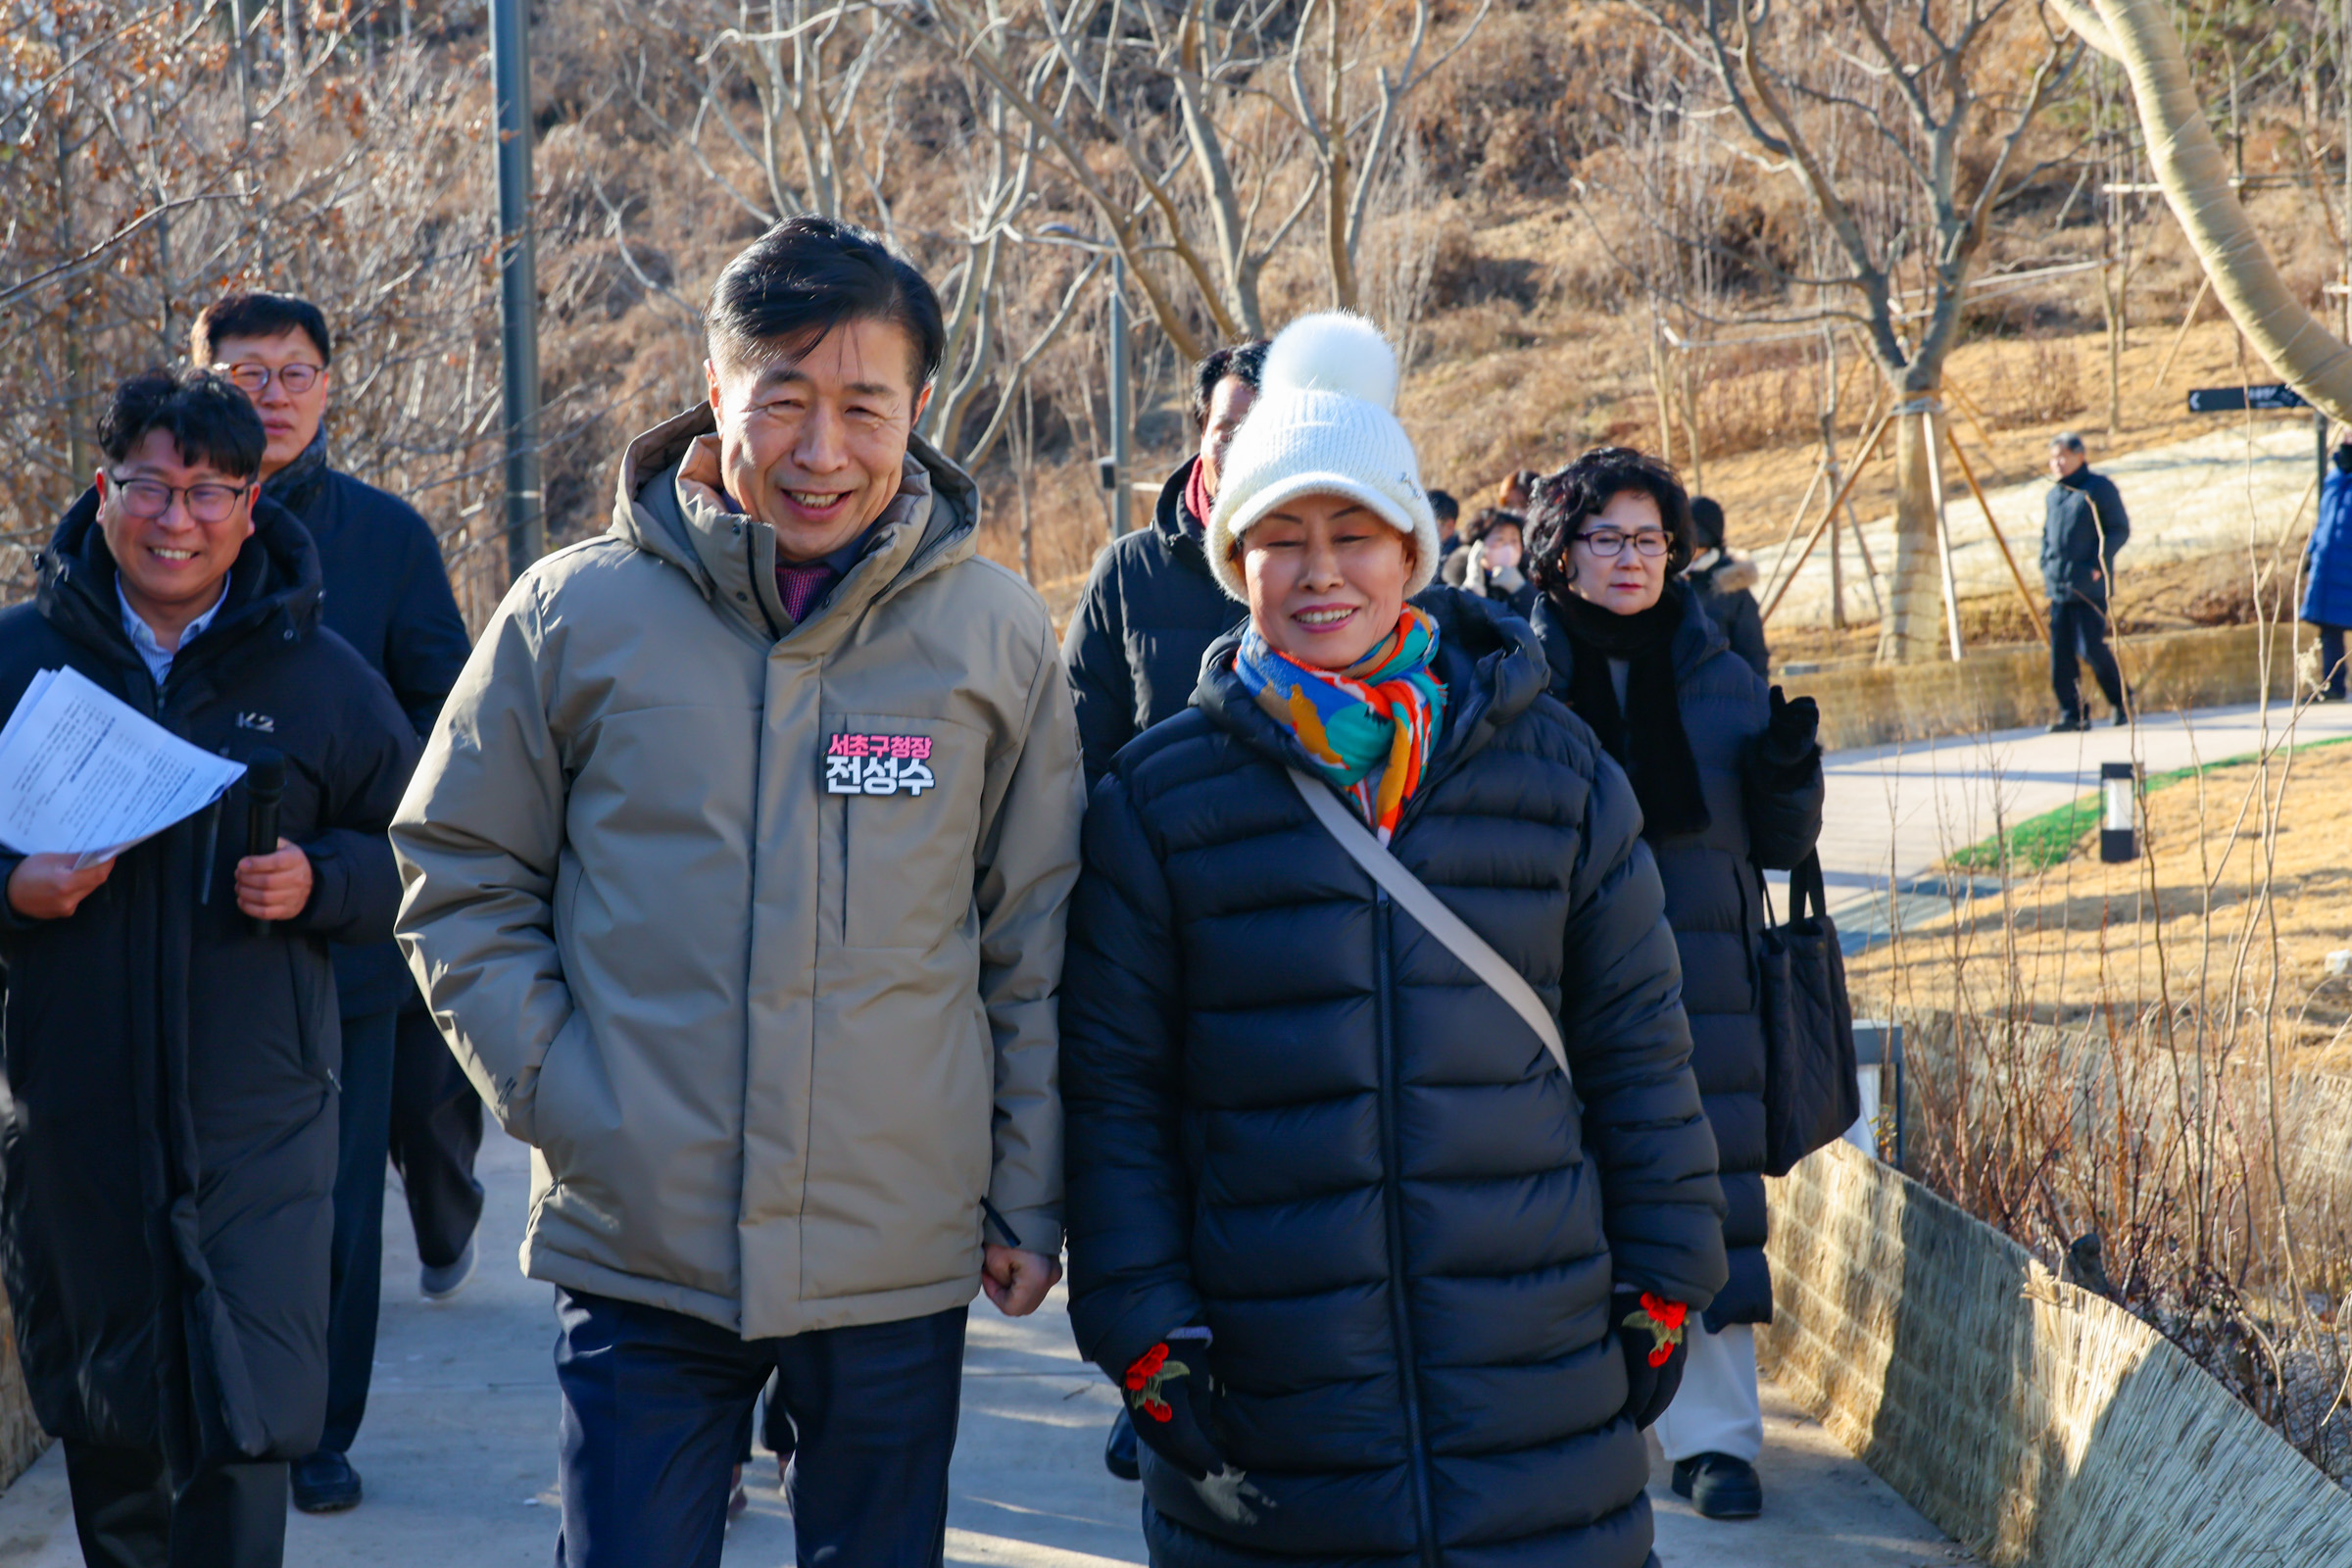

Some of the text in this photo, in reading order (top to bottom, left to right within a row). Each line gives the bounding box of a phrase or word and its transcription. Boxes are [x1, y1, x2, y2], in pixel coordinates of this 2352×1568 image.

[238, 711, 274, 733] K2
[828, 734, 932, 759] 서초구청장
[826, 756, 935, 795] 전성수
